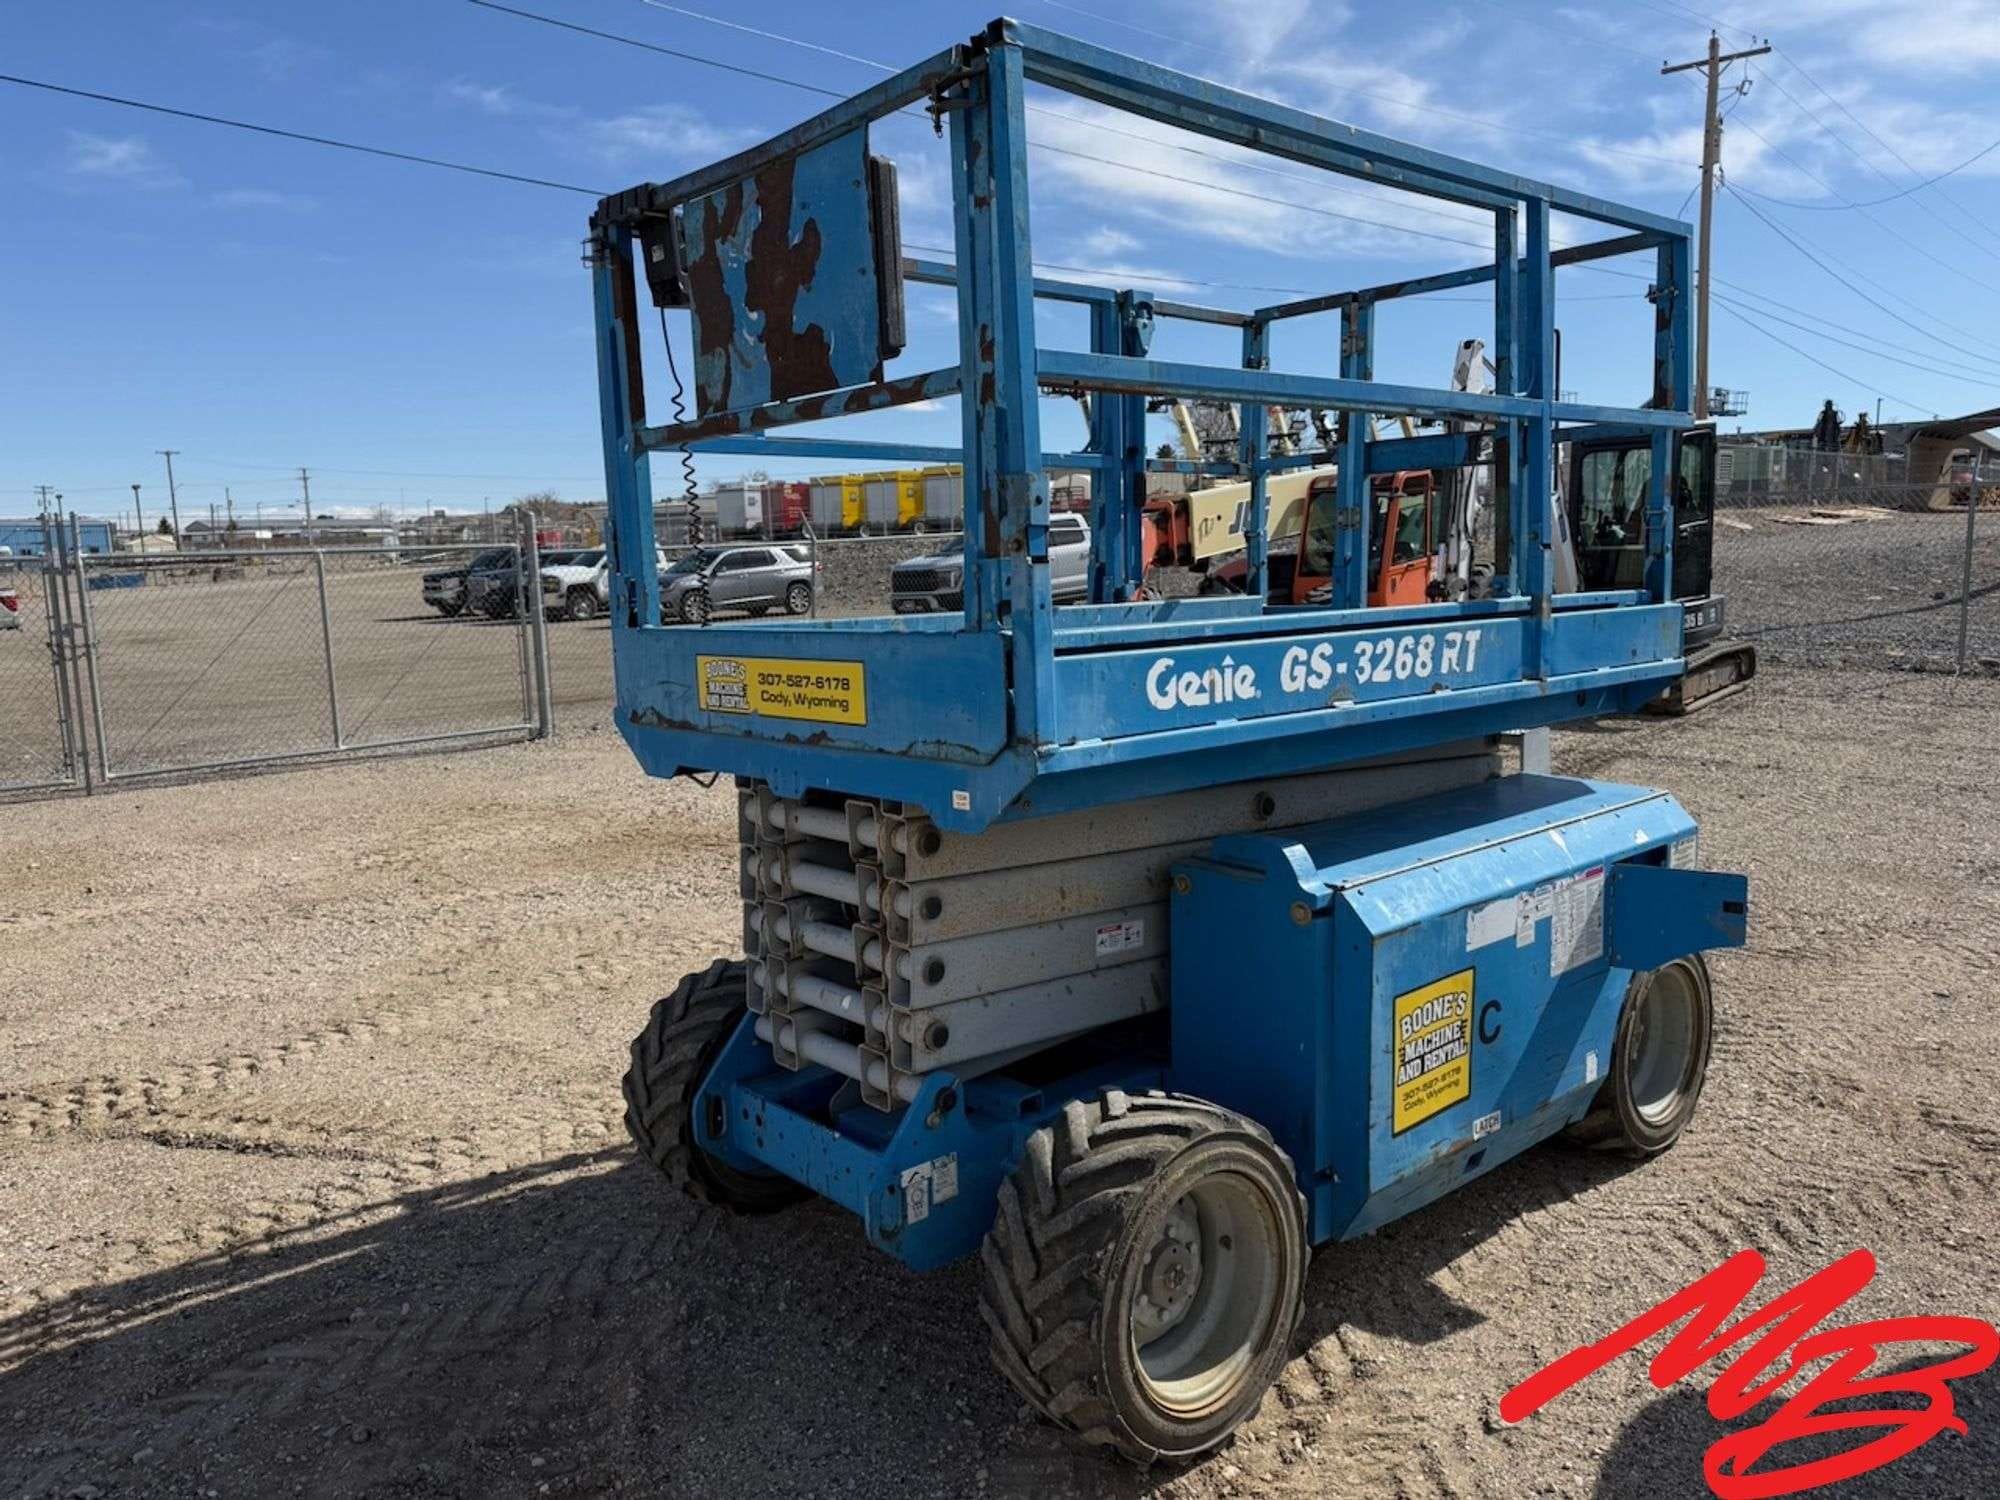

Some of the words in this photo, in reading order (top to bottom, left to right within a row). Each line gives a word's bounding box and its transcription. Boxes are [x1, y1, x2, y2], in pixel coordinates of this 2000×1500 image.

[757, 672, 851, 691] 307-527-6178
[1146, 654, 1257, 710] Genie
[1440, 629, 1482, 673] RT
[760, 690, 792, 708] Cody,
[794, 692, 849, 713] Wyoming
[1401, 993, 1467, 1041] BOONE'S
[1398, 1058, 1423, 1084] AND
[1424, 1038, 1467, 1074] RENTAL
[1404, 1020, 1462, 1062] MACHINE
[1403, 1066, 1461, 1101] 307-527-6178
